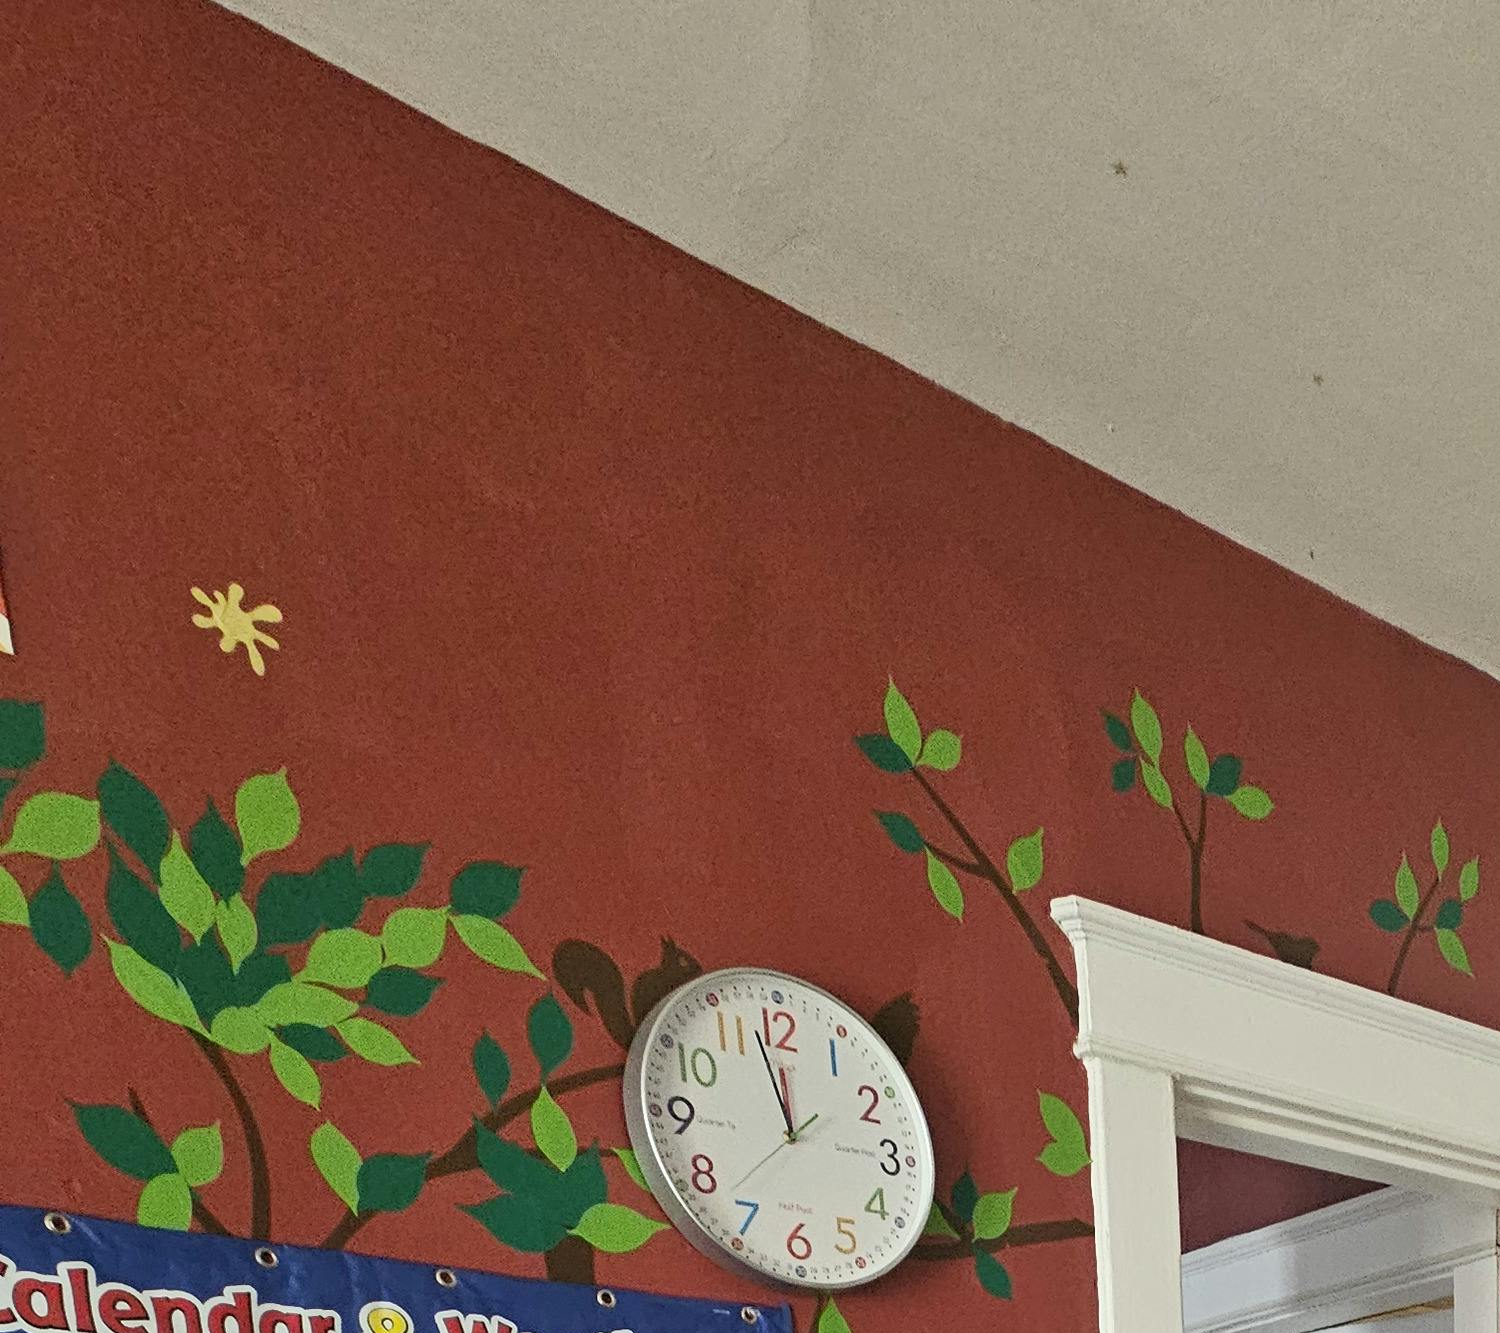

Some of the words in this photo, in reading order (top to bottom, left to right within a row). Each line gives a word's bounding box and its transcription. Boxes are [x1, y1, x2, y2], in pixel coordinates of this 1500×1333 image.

[717, 1011, 745, 1055] 11
[762, 1008, 798, 1053] 12
[678, 1042, 718, 1088] 10
[829, 1040, 838, 1077] 1
[667, 1096, 695, 1135] 9
[858, 1085, 881, 1125] 2
[691, 1155, 717, 1194] 8
[880, 1139, 900, 1176] 3
[735, 1199, 759, 1236] 7
[864, 1187, 889, 1220] 4
[787, 1224, 812, 1259] 6
[835, 1217, 857, 1254] 5
